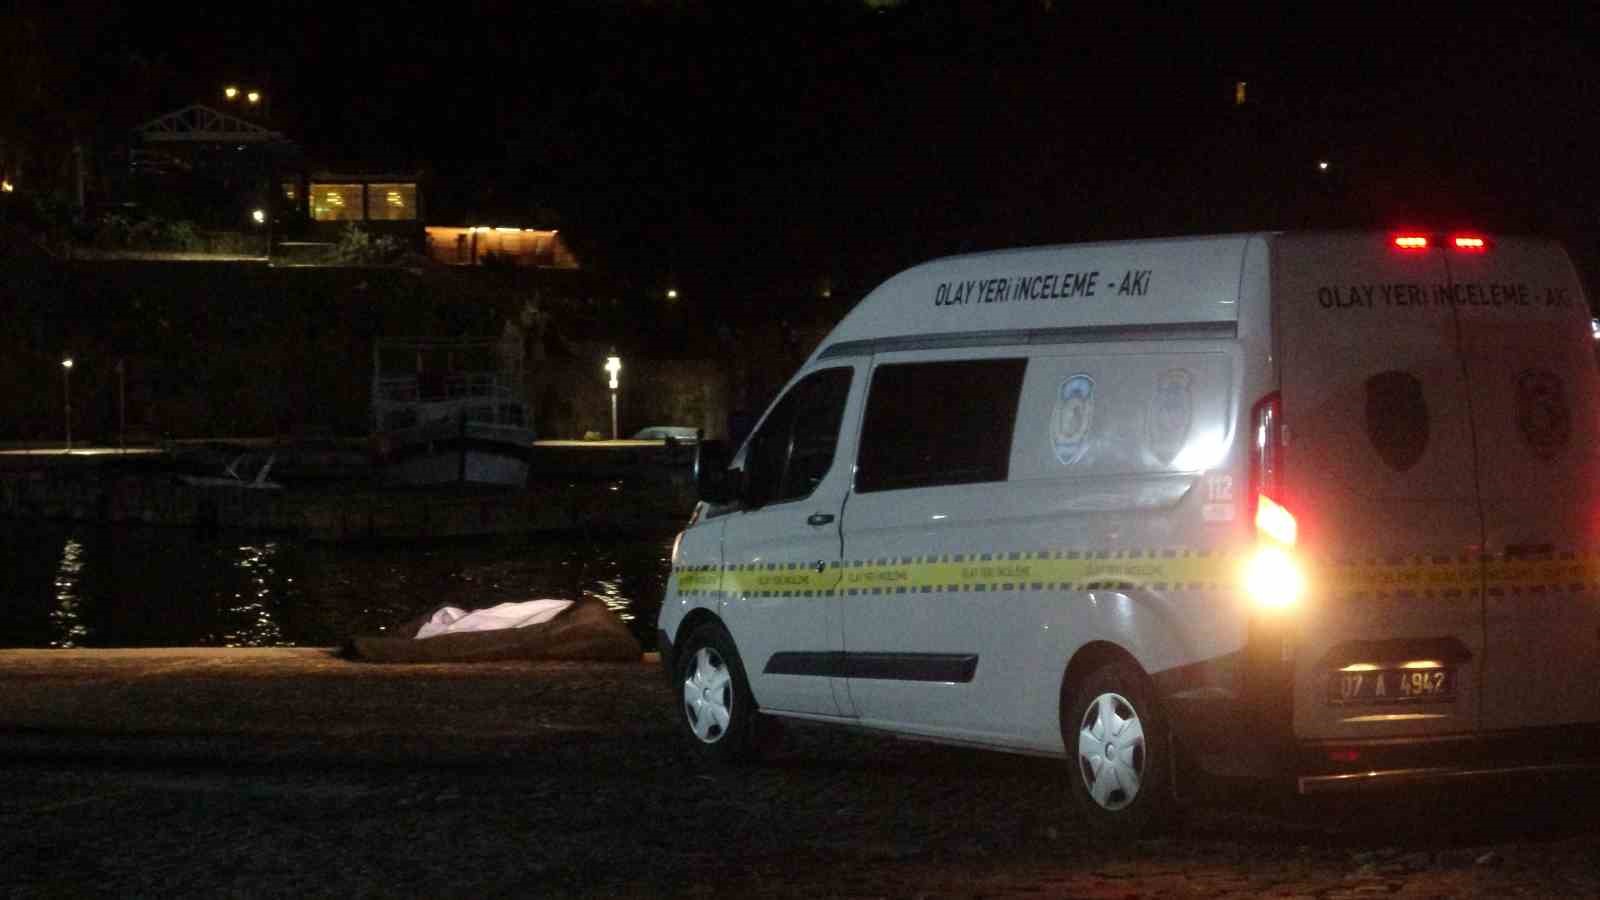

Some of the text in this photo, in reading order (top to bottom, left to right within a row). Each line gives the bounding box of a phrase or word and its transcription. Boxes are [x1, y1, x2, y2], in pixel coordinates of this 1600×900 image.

[935, 280, 975, 306] OLAY
[1317, 286, 1376, 309] OLAY
[1376, 674, 1386, 696] A
